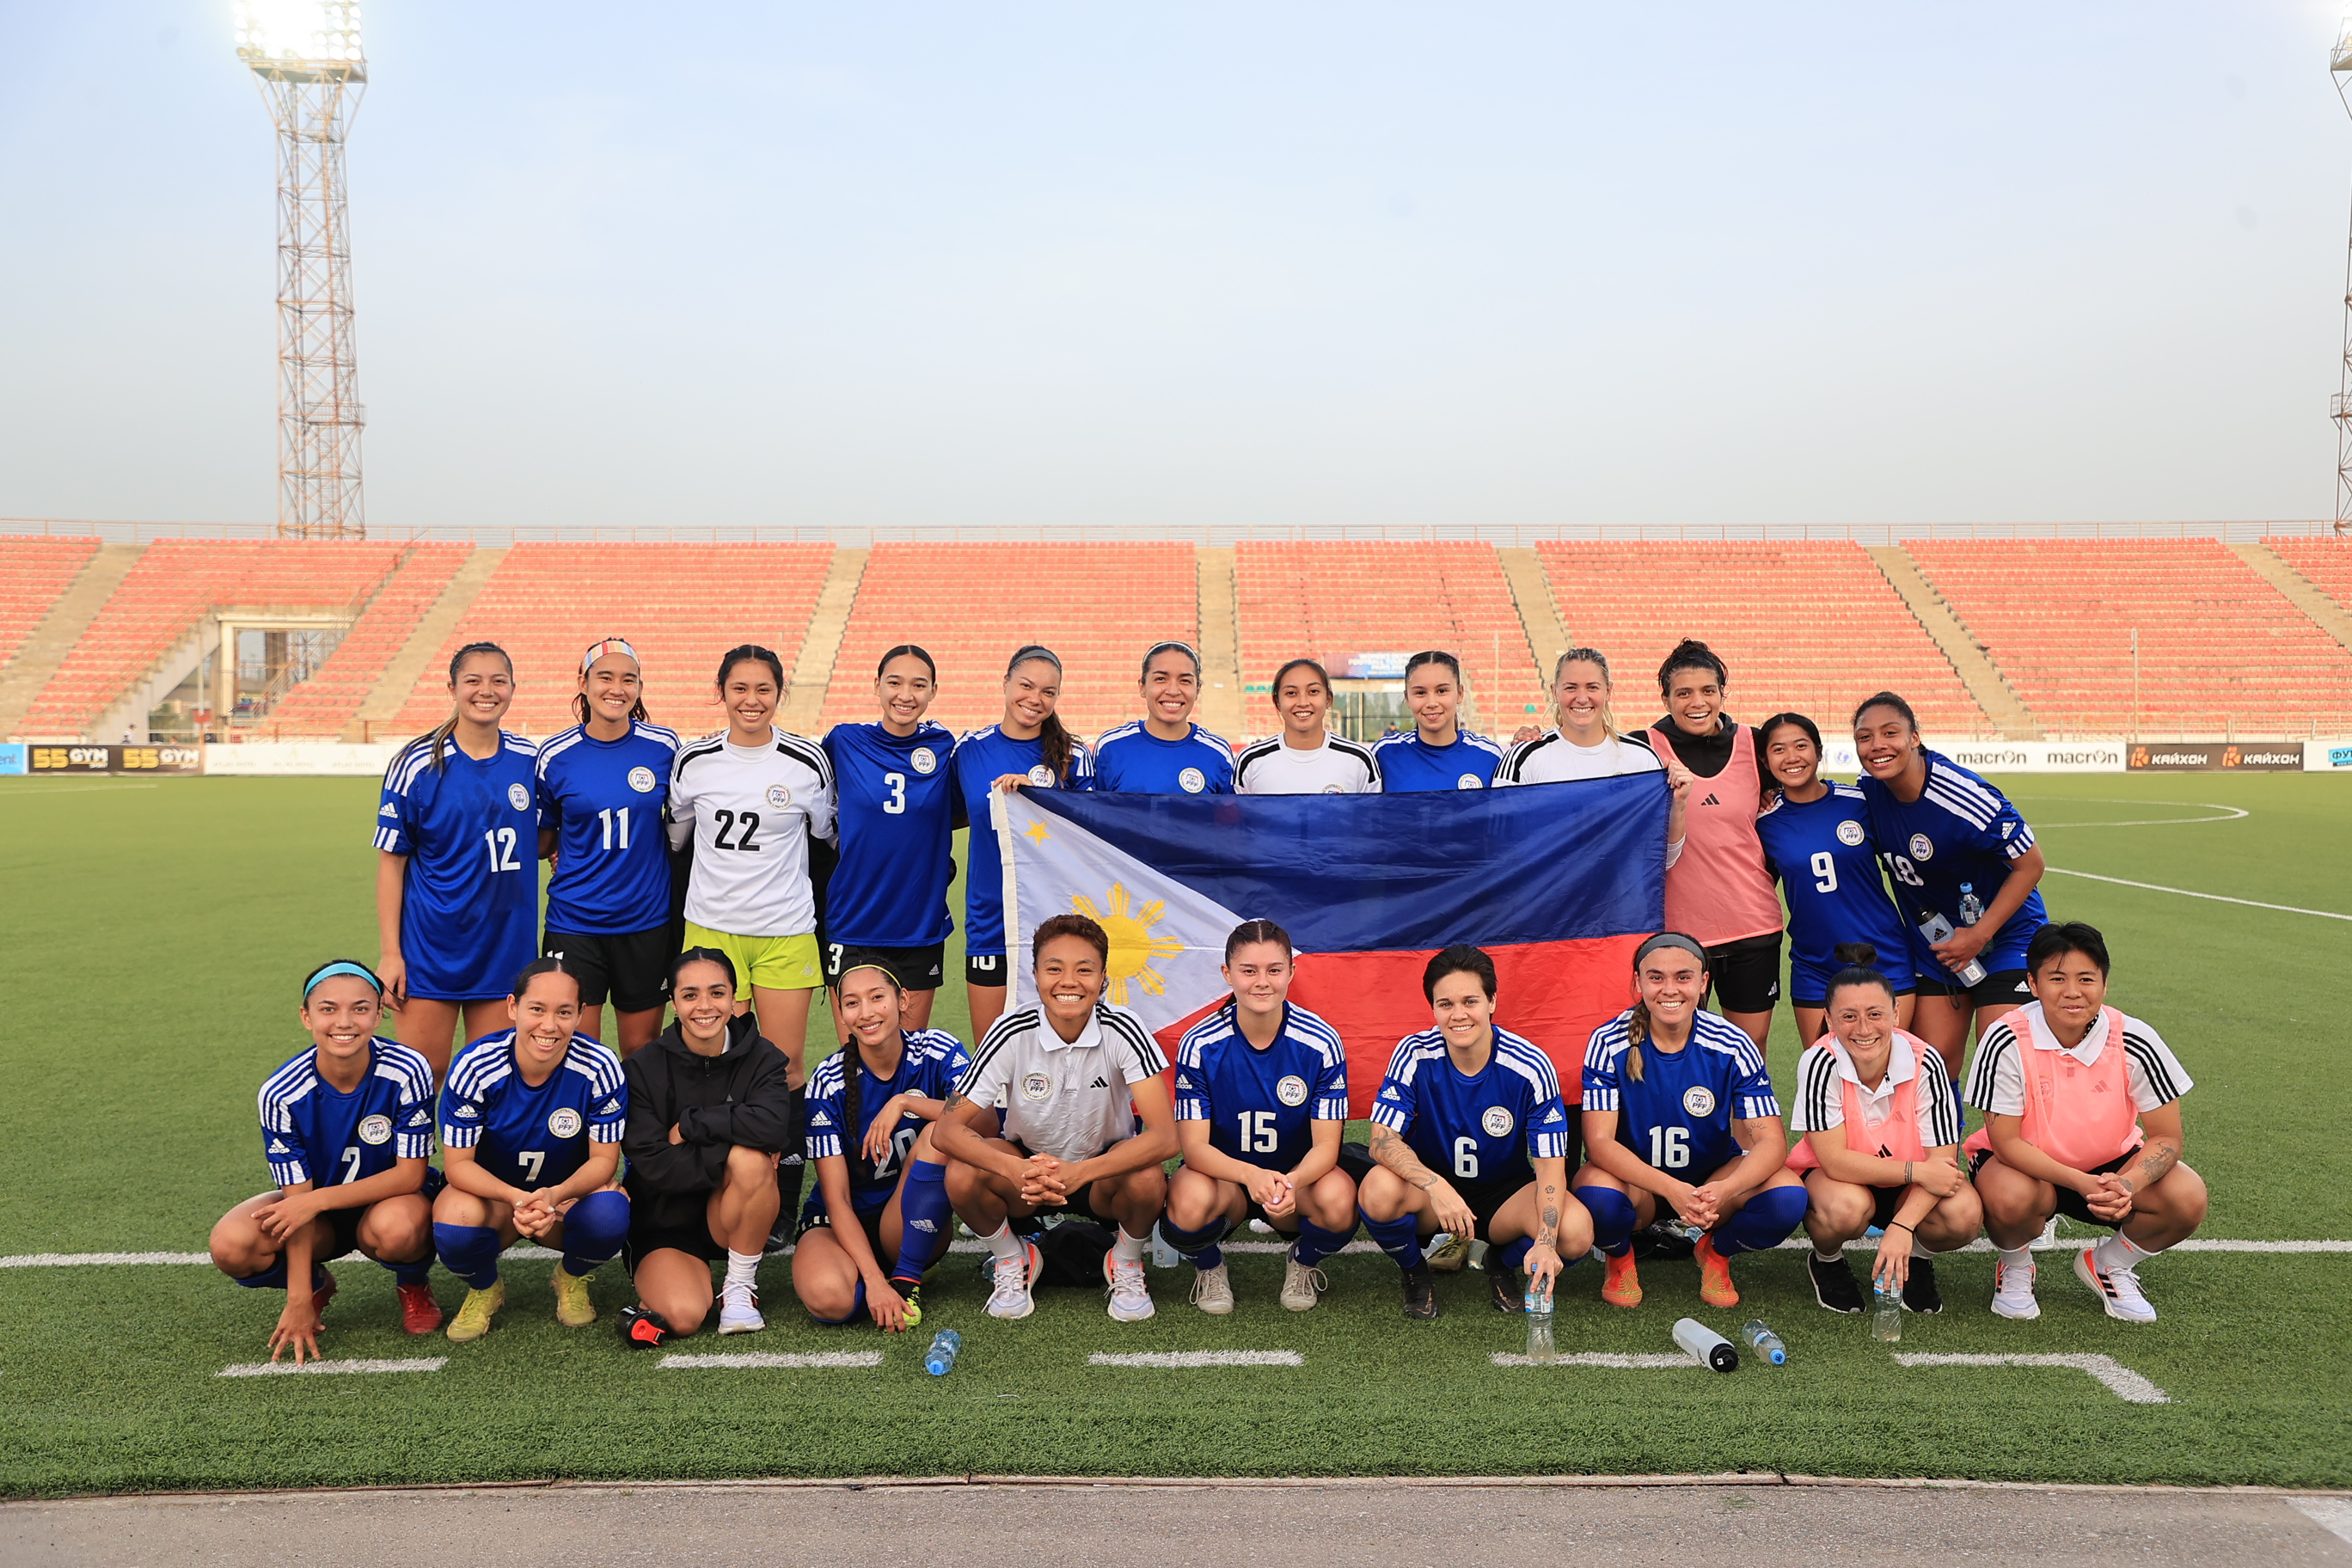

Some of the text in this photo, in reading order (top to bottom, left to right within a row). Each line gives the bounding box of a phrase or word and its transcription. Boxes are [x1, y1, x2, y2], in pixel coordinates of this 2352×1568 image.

[33, 747, 108, 769] 55 GYM
[123, 747, 200, 769] 55 GYM
[2151, 752, 2208, 765] КАЙХОН
[2243, 752, 2300, 765] КАЙХОН
[884, 772, 905, 814] 3
[599, 807, 628, 849] 11
[714, 809, 760, 851] 22
[485, 827, 521, 873] 12
[1883, 852, 1924, 886] 18
[1810, 851, 1837, 893] 9
[828, 942, 843, 975] 3
[408, 1118, 432, 1127] adidas
[1238, 1111, 1277, 1153] 15
[1543, 1115, 1563, 1124] adidas
[341, 1146, 361, 1185] 2
[518, 1150, 545, 1182] 7
[874, 1128, 917, 1180] 20
[1455, 1136, 1479, 1178] 6
[1649, 1125, 1690, 1168] 16
